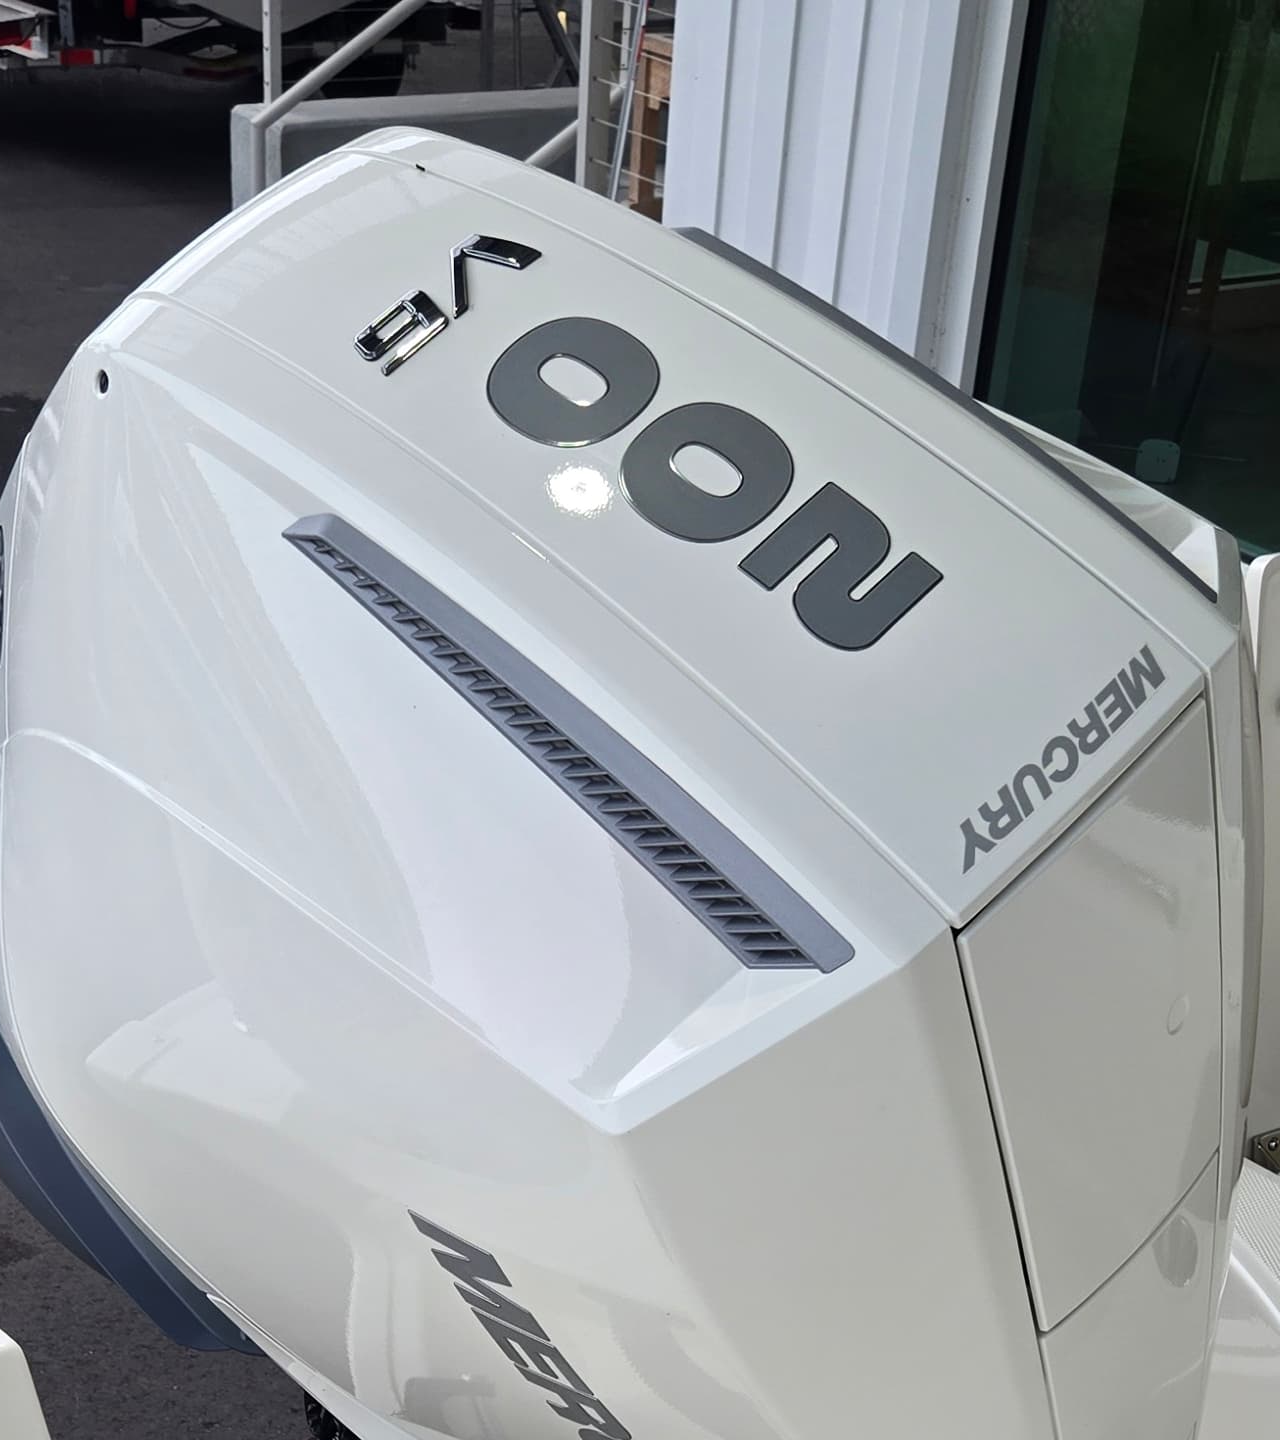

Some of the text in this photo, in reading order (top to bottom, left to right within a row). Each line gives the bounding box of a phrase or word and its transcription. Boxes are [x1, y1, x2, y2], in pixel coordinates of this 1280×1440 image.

[354, 233, 543, 377] V6
[486, 315, 944, 652] 200
[961, 643, 1166, 875] MERCURY
